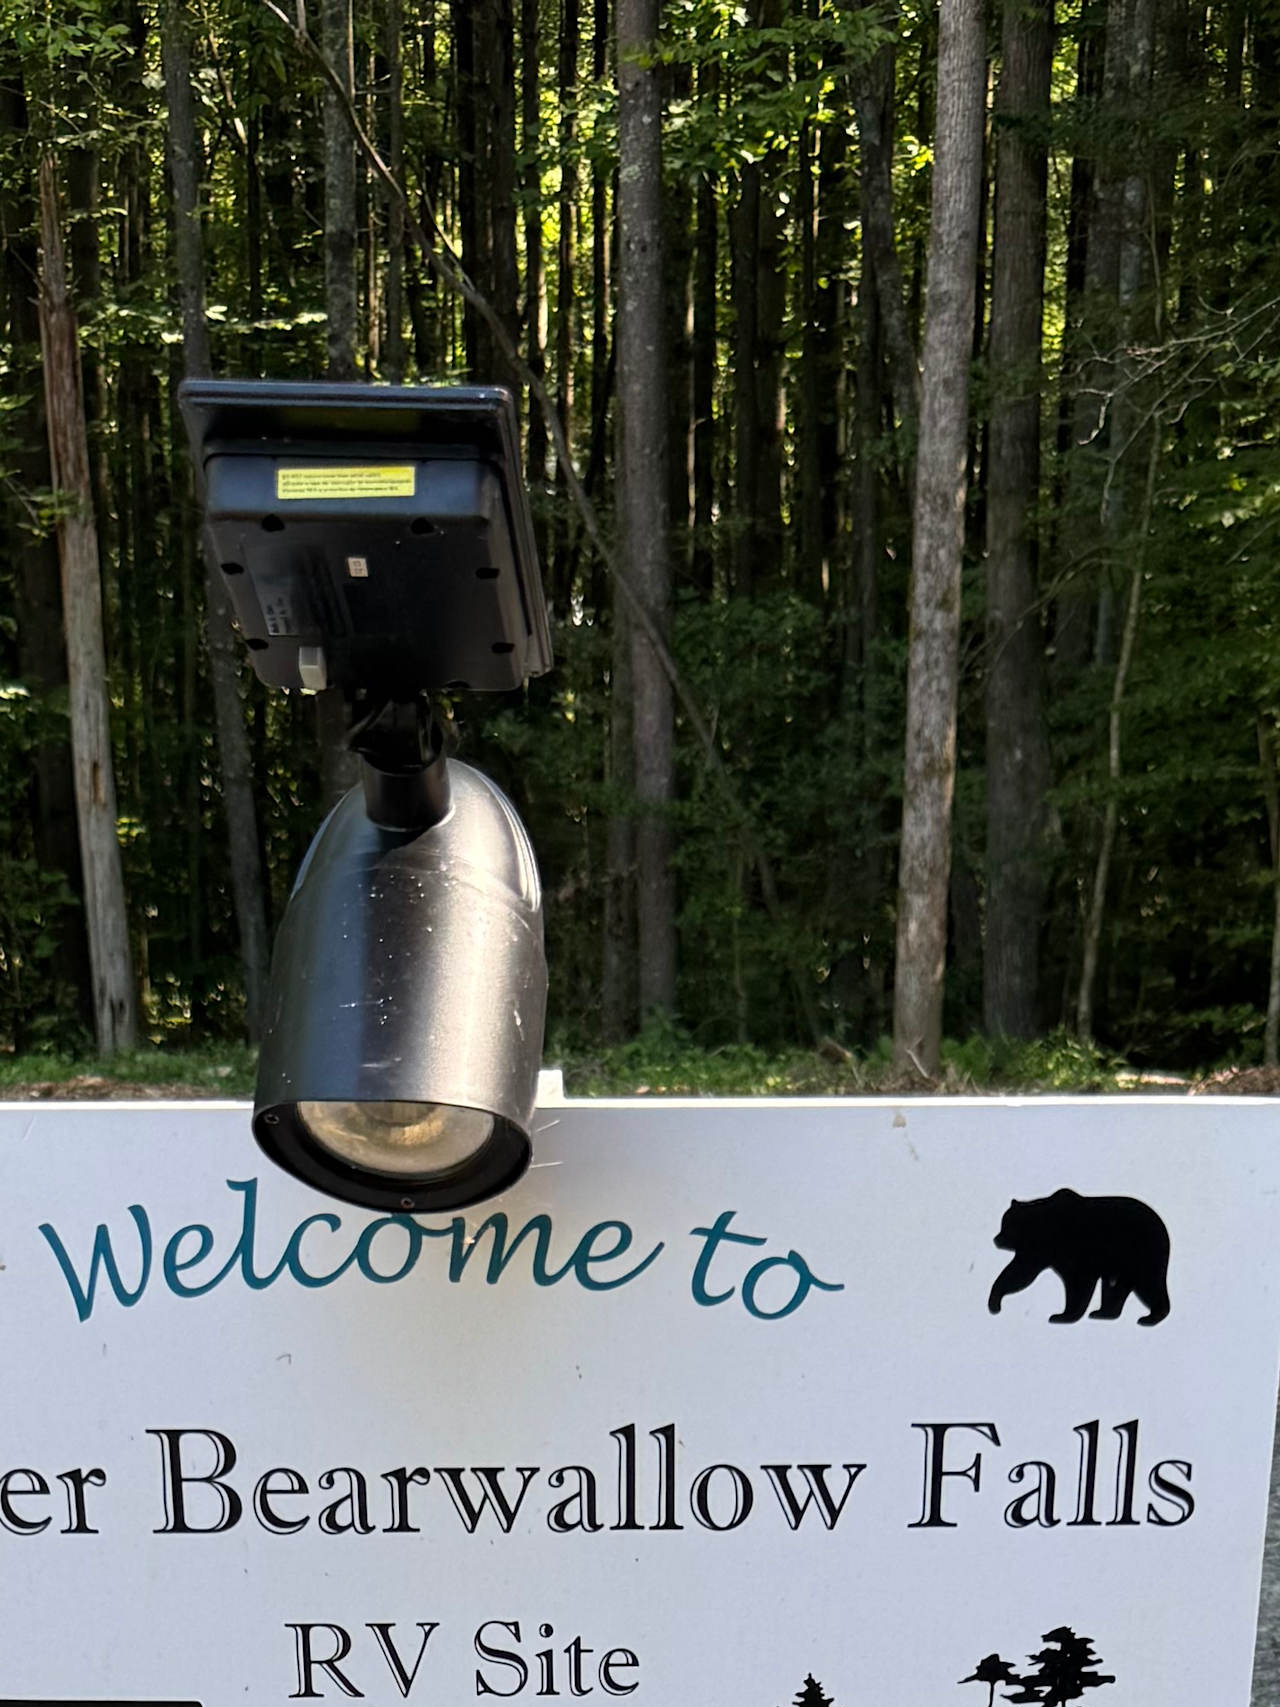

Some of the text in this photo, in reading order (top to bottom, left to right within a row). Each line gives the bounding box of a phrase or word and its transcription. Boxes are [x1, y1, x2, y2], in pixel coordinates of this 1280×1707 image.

[38, 1177, 844, 1322] Welcome to
[145, 1423, 867, 1535] Bearwallow
[907, 1419, 1194, 1528] Falls
[284, 1621, 639, 1698] RV Site
